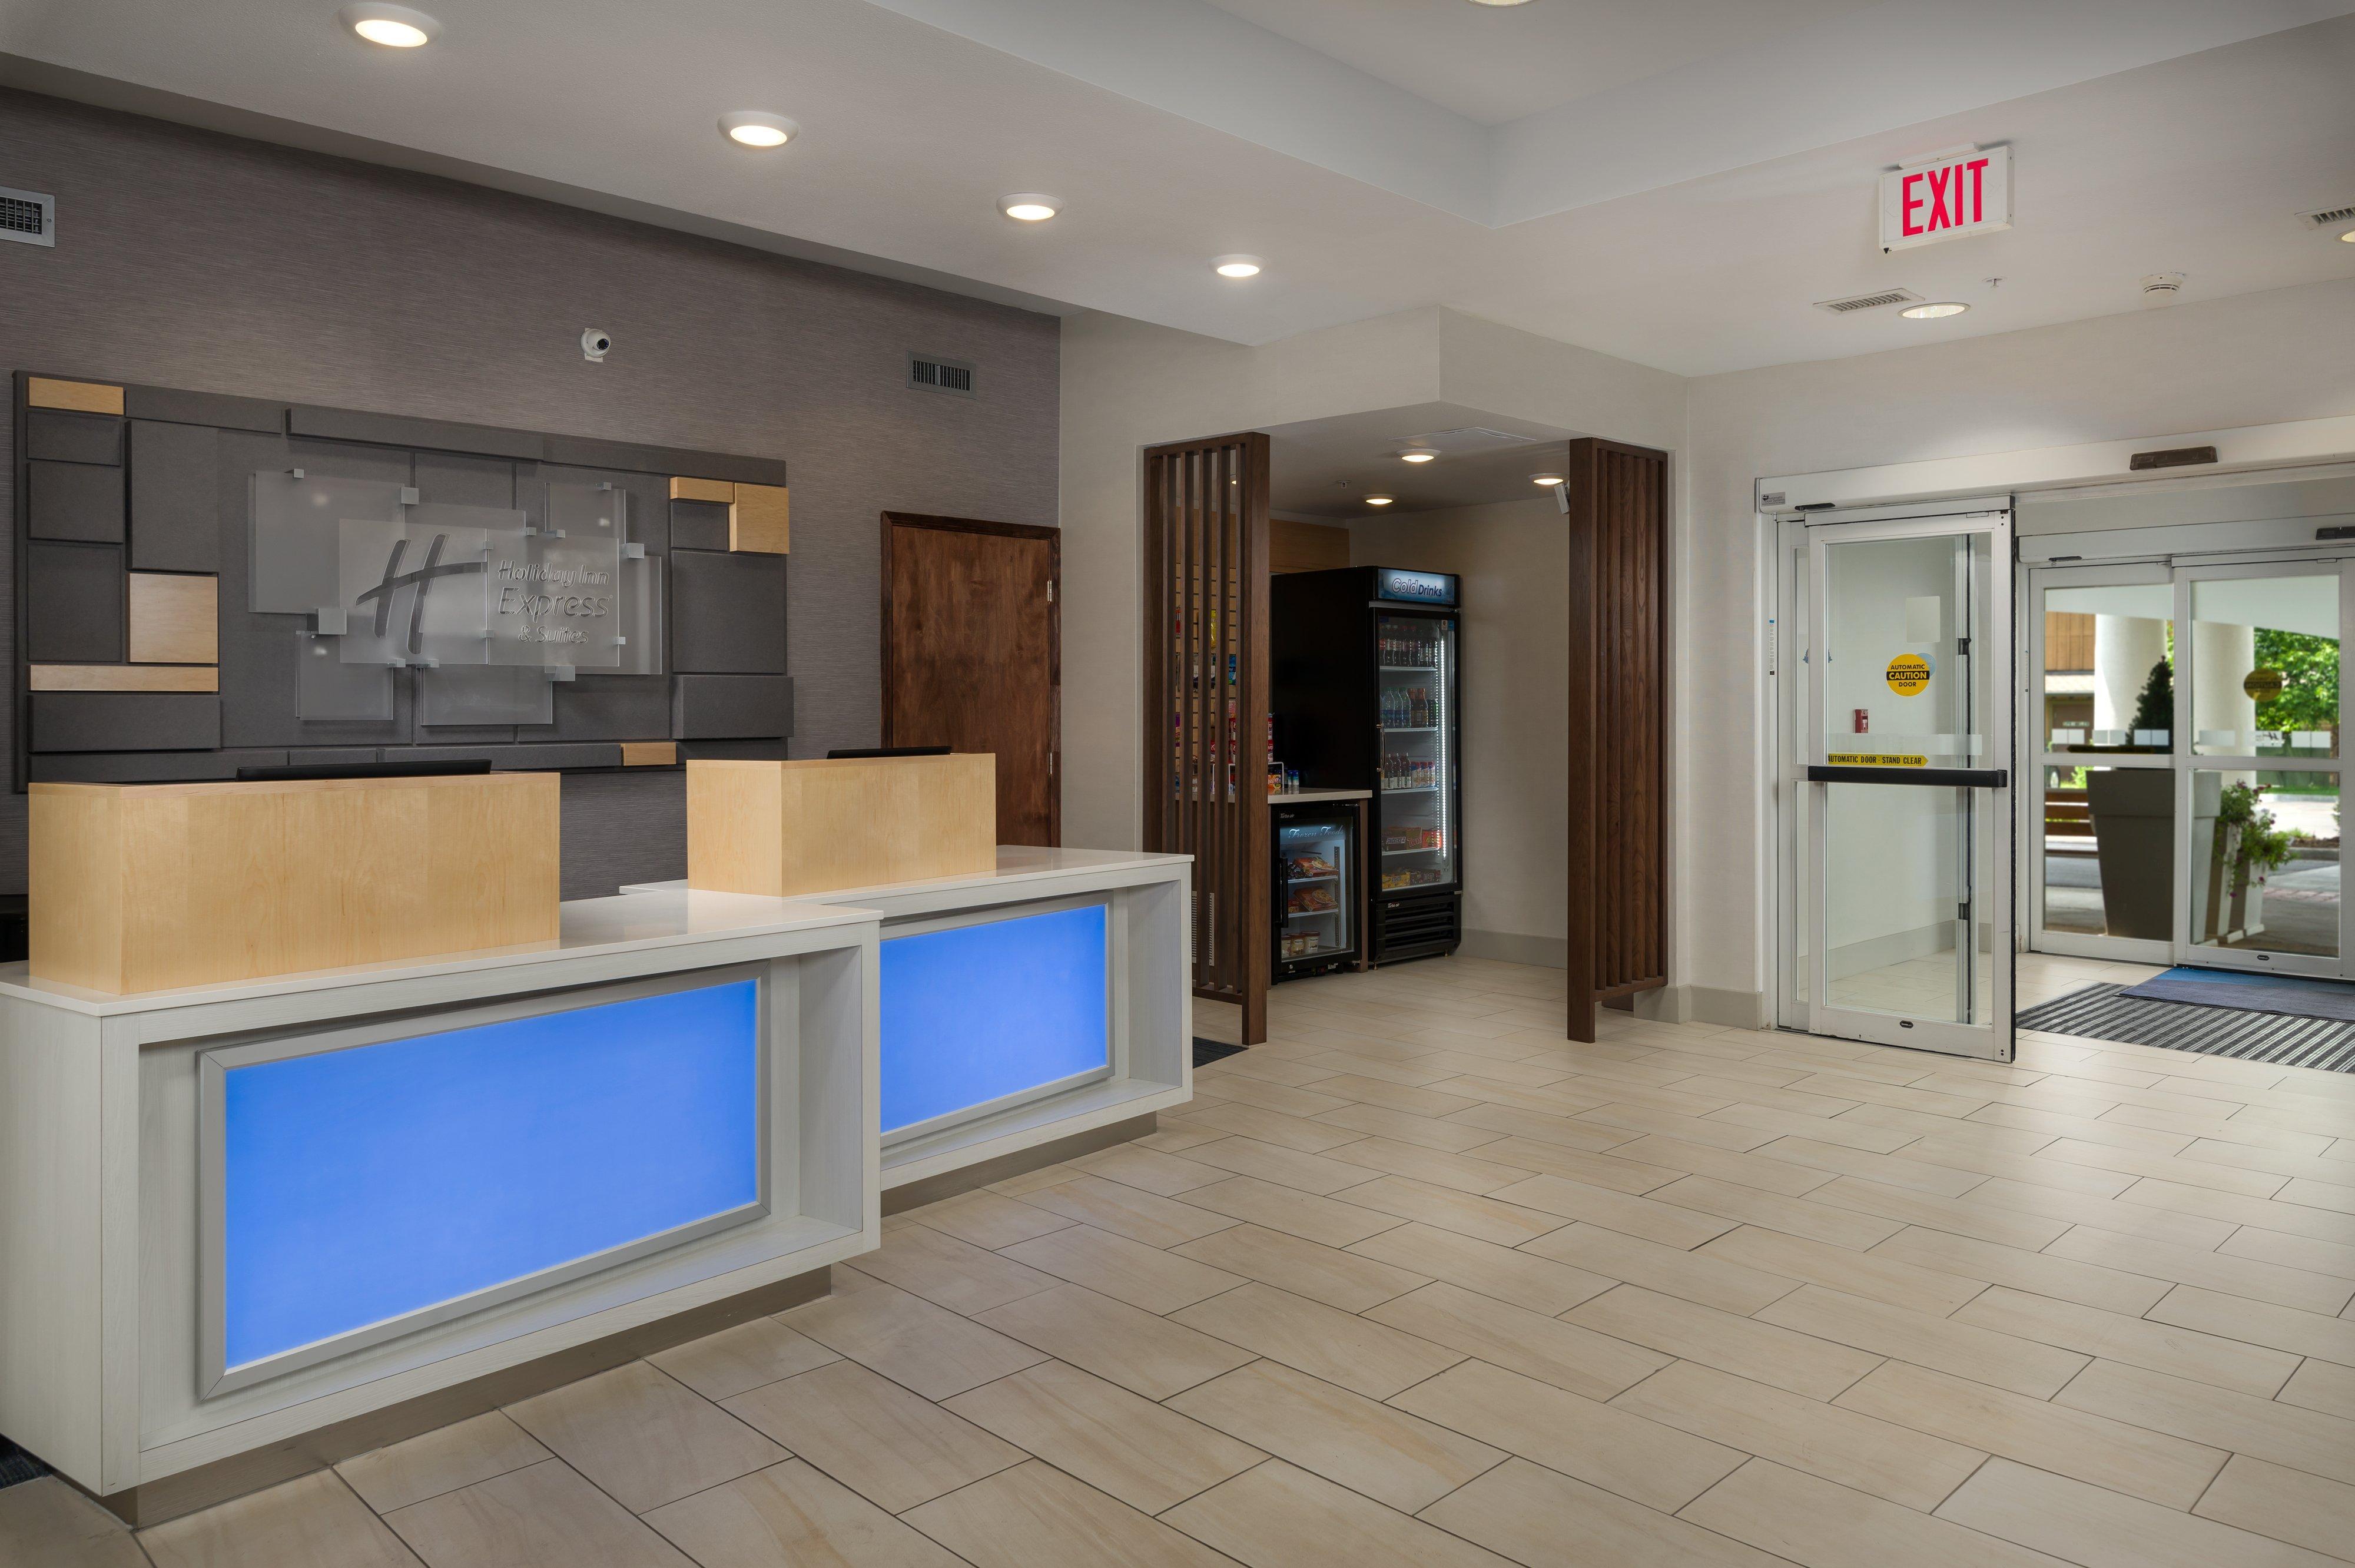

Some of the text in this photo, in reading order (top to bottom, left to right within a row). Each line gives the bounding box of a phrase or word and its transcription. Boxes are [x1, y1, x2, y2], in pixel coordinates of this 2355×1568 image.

[1902, 158, 1989, 237] EXIT
[498, 560, 609, 588] Holiday Inn
[1392, 578, 1442, 596] Cold Drinks
[499, 587, 609, 624] Express
[519, 625, 589, 643] & Suites
[1828, 755, 1858, 763] AUTOMATIC
[1288, 825, 1344, 838] Frozen Foods
